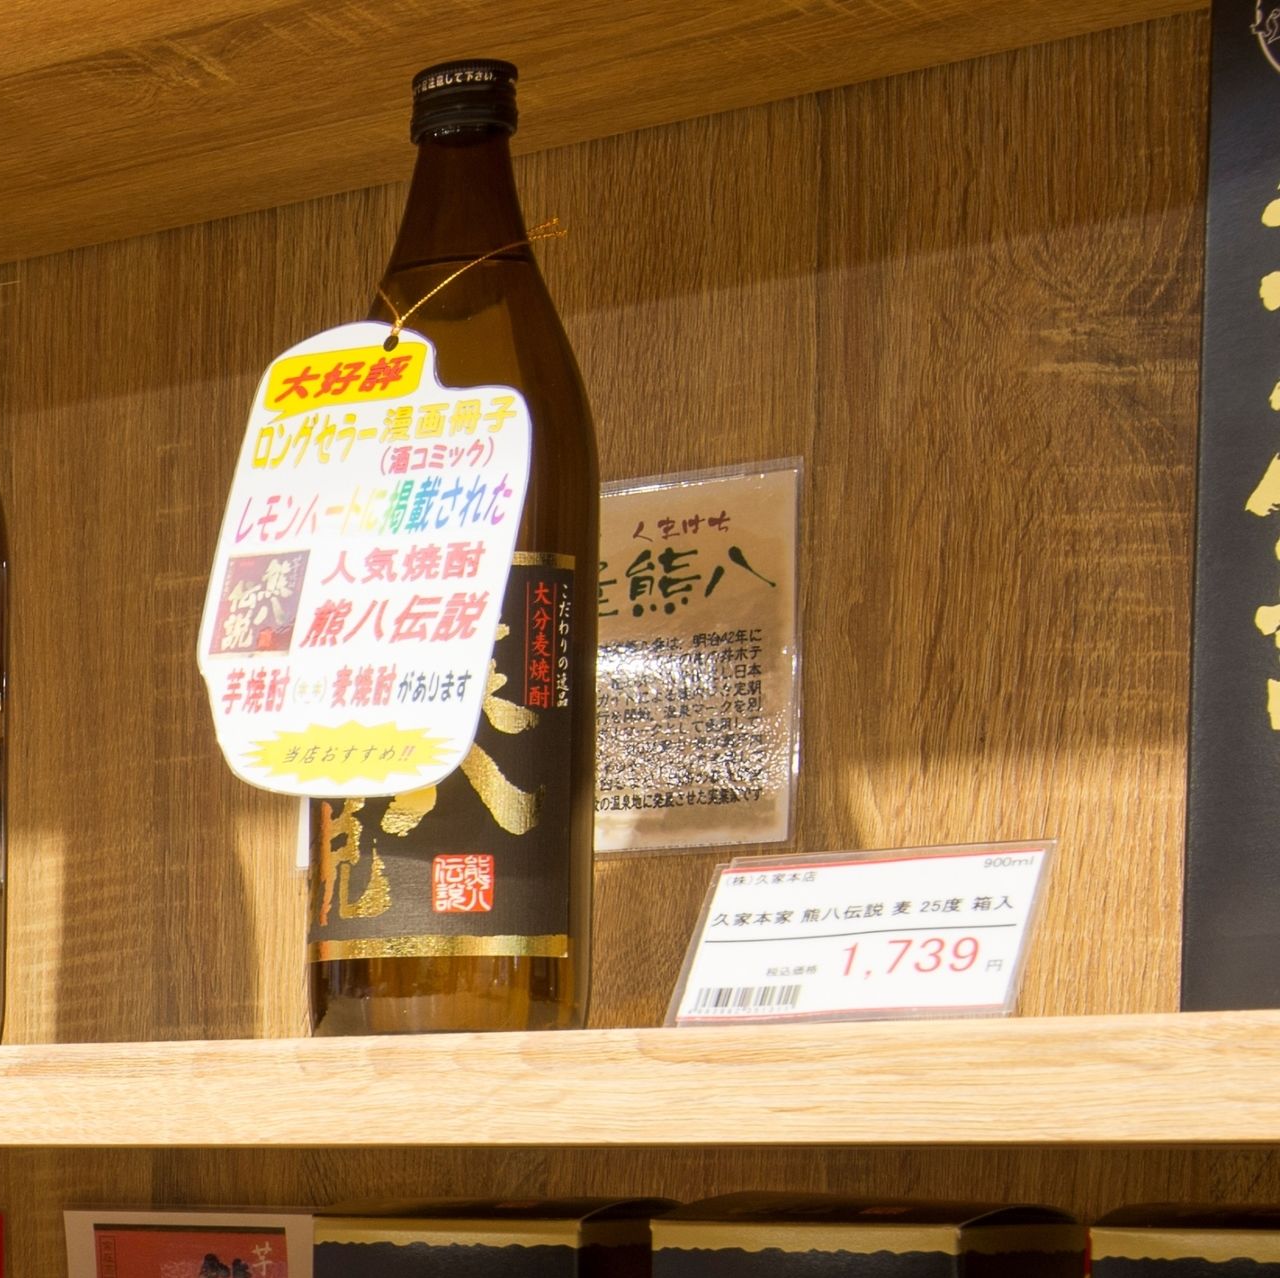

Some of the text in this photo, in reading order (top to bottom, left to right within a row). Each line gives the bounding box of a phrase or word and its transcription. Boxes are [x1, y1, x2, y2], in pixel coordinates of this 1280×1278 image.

[274, 354, 413, 403] 大好評
[251, 395, 519, 471] ロングセラー漫画冊子
[379, 436, 496, 477] (酒コミック)
[320, 541, 487, 586] 人気焼酎
[298, 590, 489, 648] 熊八伝説
[528, 582, 551, 709] 大分麦焼酎
[556, 583, 574, 708] こだわりの逸品
[221, 663, 473, 714] 芋焼酎 麦焼酎 があります
[711, 895, 1016, 928] 久家本家 熊八伝説 麦 25度 箱入
[842, 937, 981, 980] 1,739
[985, 958, 1004, 973] 円
